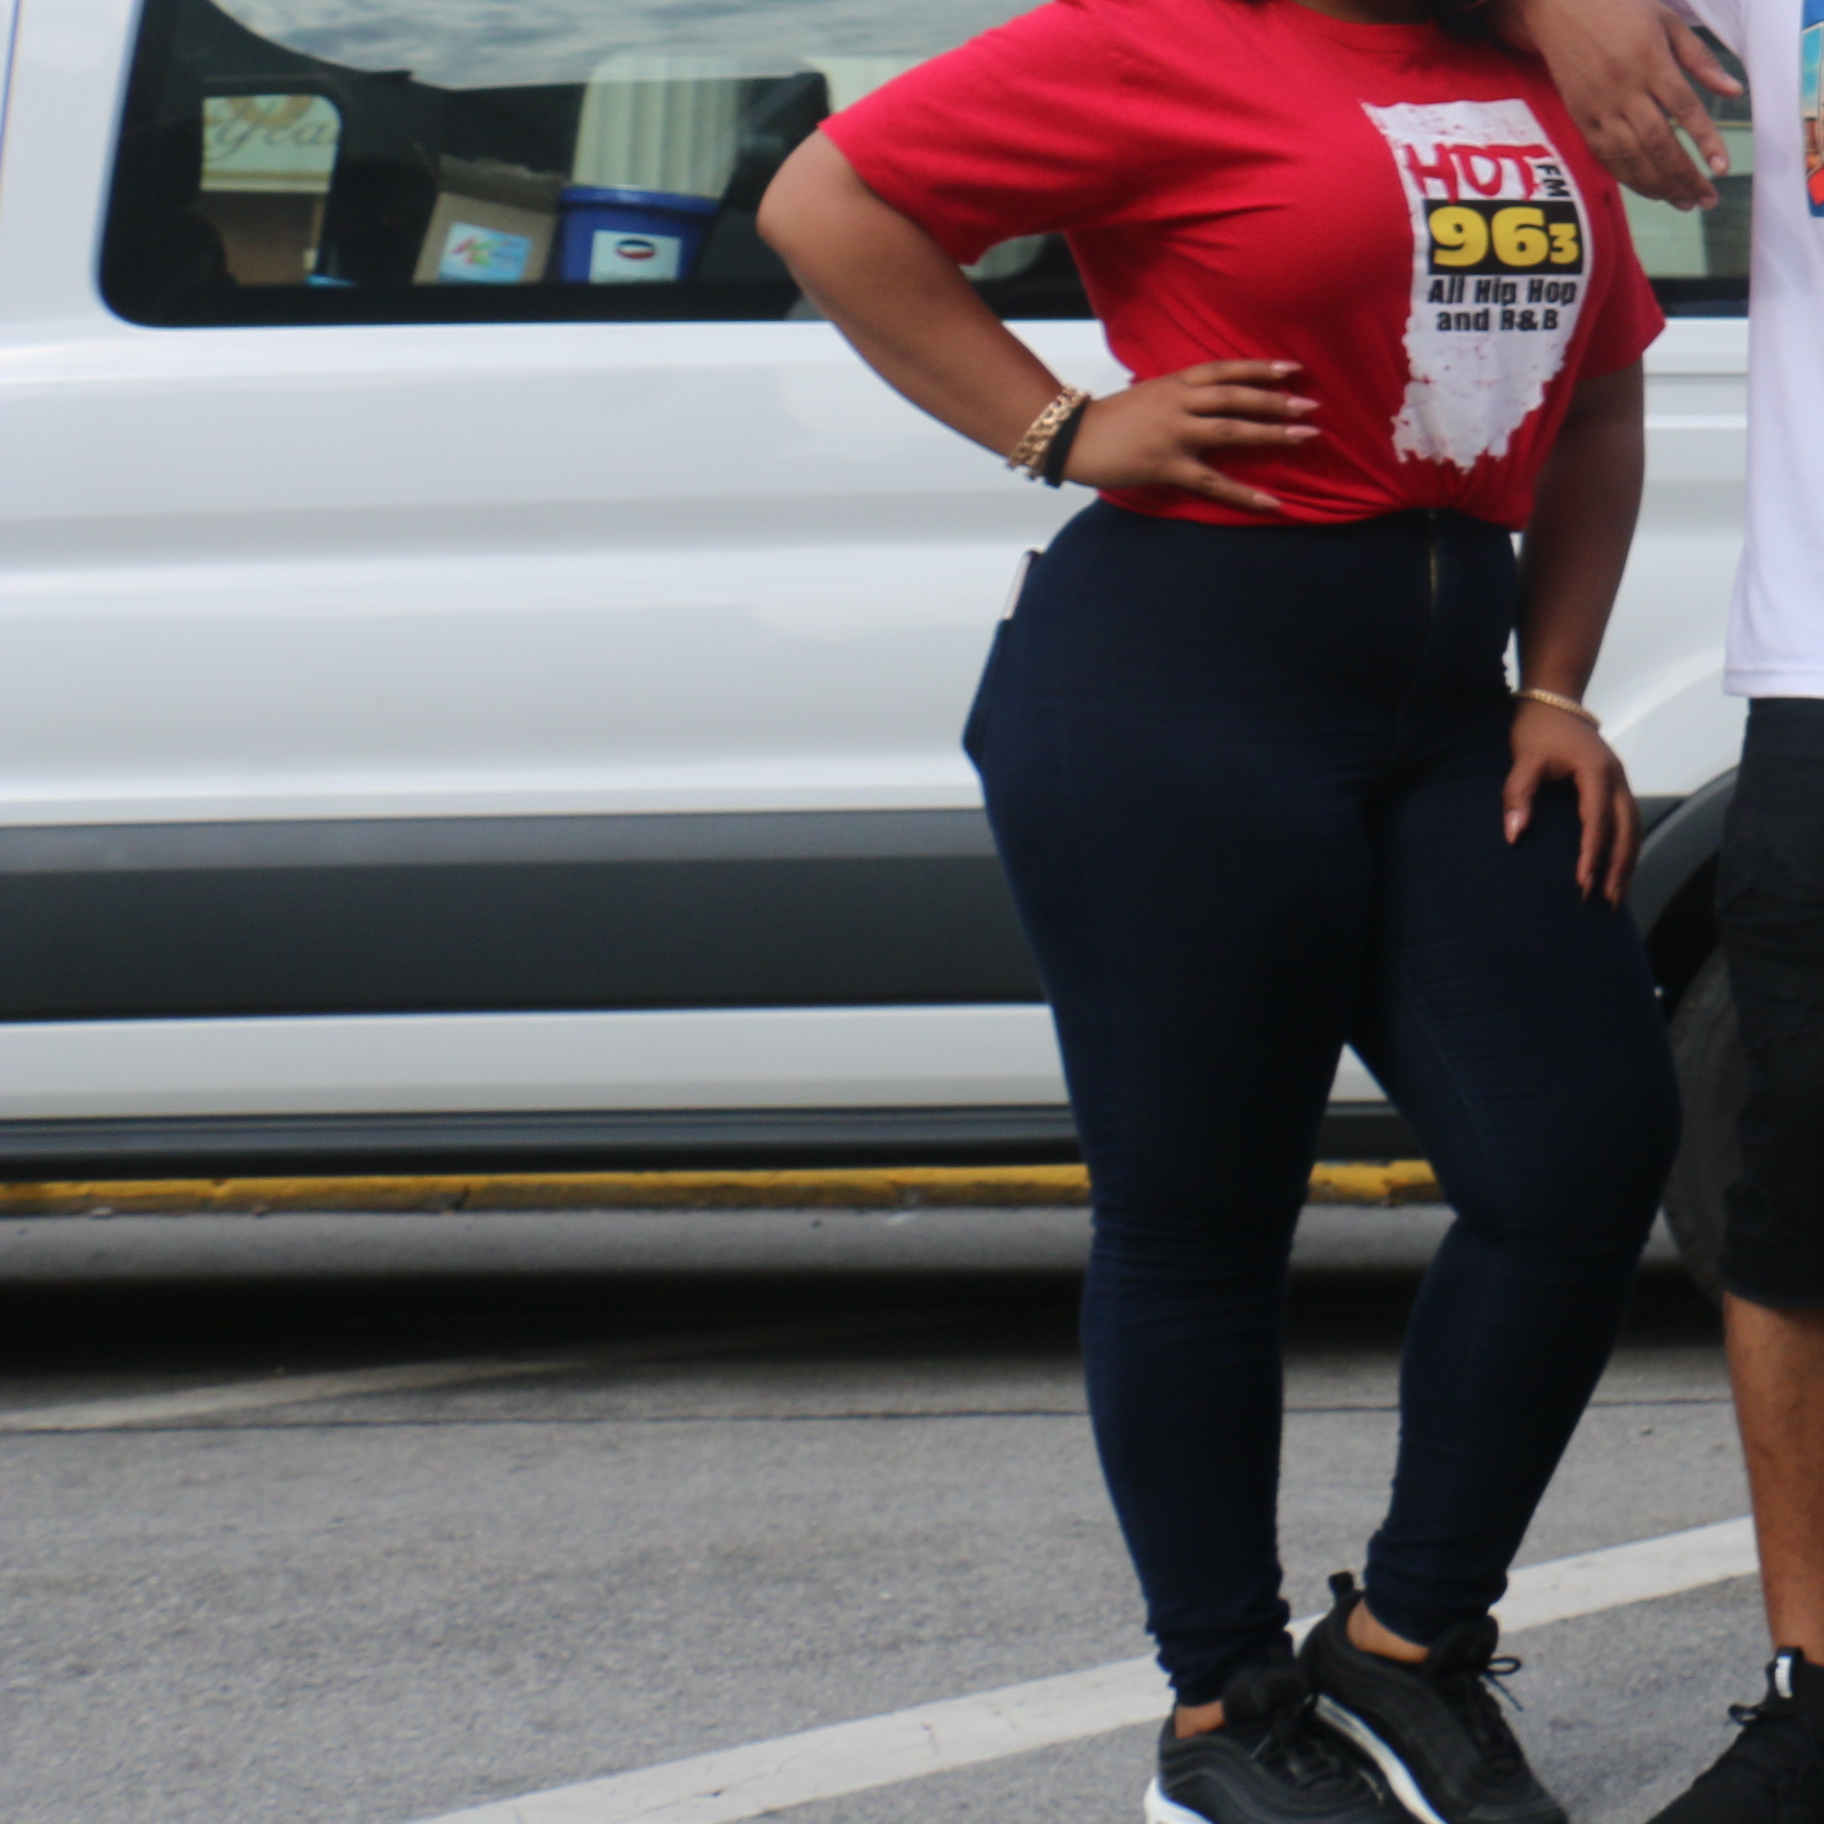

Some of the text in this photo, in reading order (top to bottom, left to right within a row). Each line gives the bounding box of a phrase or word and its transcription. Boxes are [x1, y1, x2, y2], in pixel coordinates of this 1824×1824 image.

[1401, 143, 1553, 204] HOT
[1535, 163, 1571, 198] FM
[1427, 277, 1577, 307] All Hip Hop
[1437, 309, 1559, 332] and R&B
